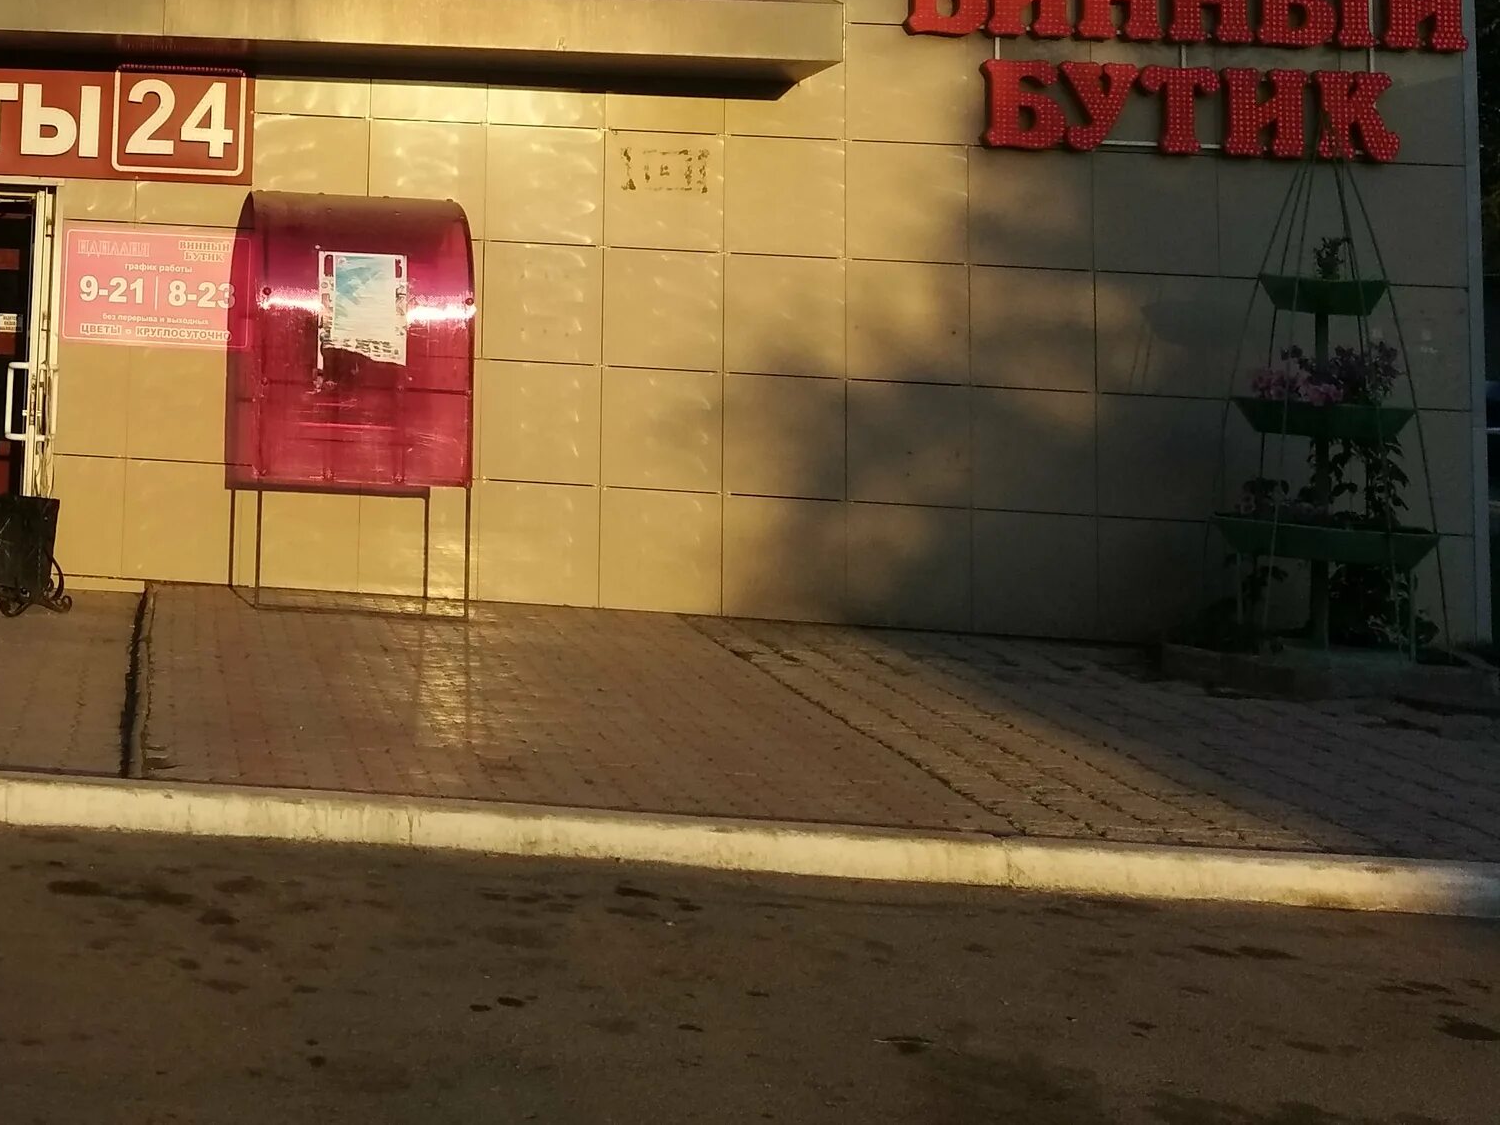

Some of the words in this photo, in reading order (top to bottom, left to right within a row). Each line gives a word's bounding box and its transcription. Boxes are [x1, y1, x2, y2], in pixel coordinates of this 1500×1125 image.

[124, 78, 234, 158] 24
[979, 59, 1401, 163] БУТИК
[179, 240, 231, 252] ВИННЫЙ
[184, 251, 225, 262] БУТИК
[125, 263, 157, 272] график
[158, 264, 193, 273] работы
[79, 275, 145, 304] 9-21
[168, 280, 237, 309] 8-23
[102, 313, 116, 321] без
[117, 315, 158, 324] перерыва
[167, 317, 209, 325] выходных
[80, 323, 122, 334] ЦВЕТЫ
[136, 326, 232, 341] КРУГЛОСУТОЧНО
